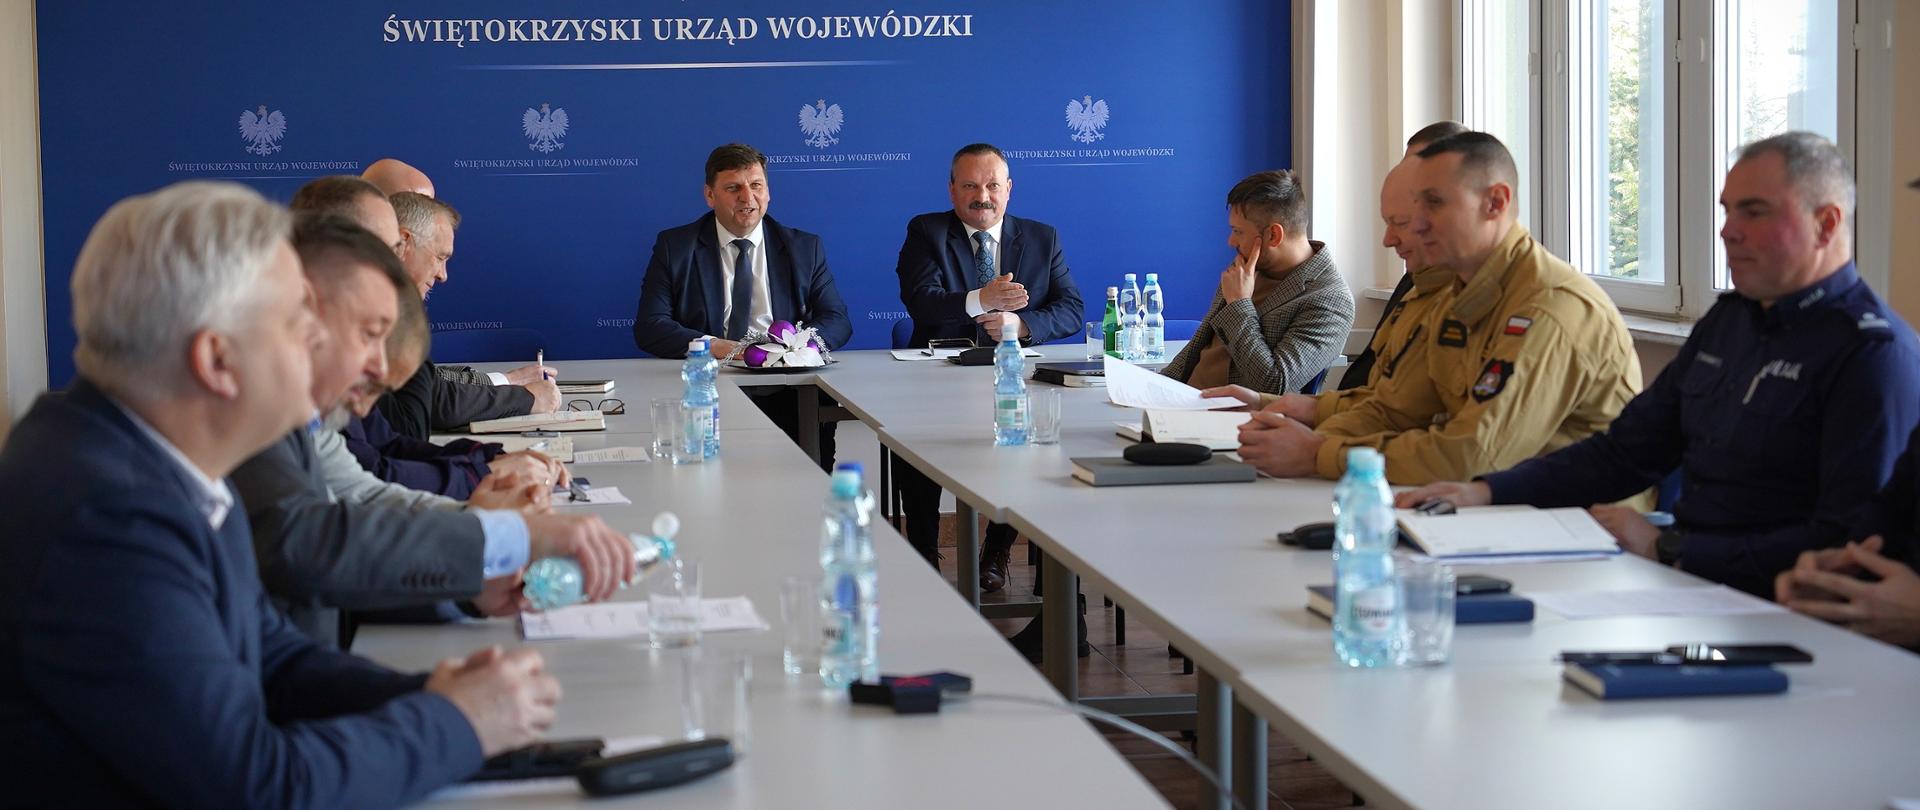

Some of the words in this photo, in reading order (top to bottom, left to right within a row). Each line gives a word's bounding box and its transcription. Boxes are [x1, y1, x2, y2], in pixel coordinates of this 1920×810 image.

[383, 14, 642, 48] ŚWIĘTOKRZYSKI
[651, 17, 758, 46] URZĄD
[766, 10, 974, 40] WOJEWÓDZKI
[813, 153, 845, 164] URZĄD
[848, 151, 912, 162] WOJEWÓDZKI
[1079, 149, 1111, 159] URZĄD
[1113, 146, 1175, 157] WOJEWÓDZKI
[168, 160, 251, 172] ŚWIĘTOKRZYSKI
[254, 161, 289, 172] URZĄD
[291, 160, 360, 171] WOJEWÓDZKI
[453, 158, 534, 170] ŚWIĘTOKRZYSKI
[537, 158, 571, 169] URZĄD
[573, 157, 639, 168] WOJEWÓDZKI
[436, 320, 504, 330] WOJEWÓDZKI
